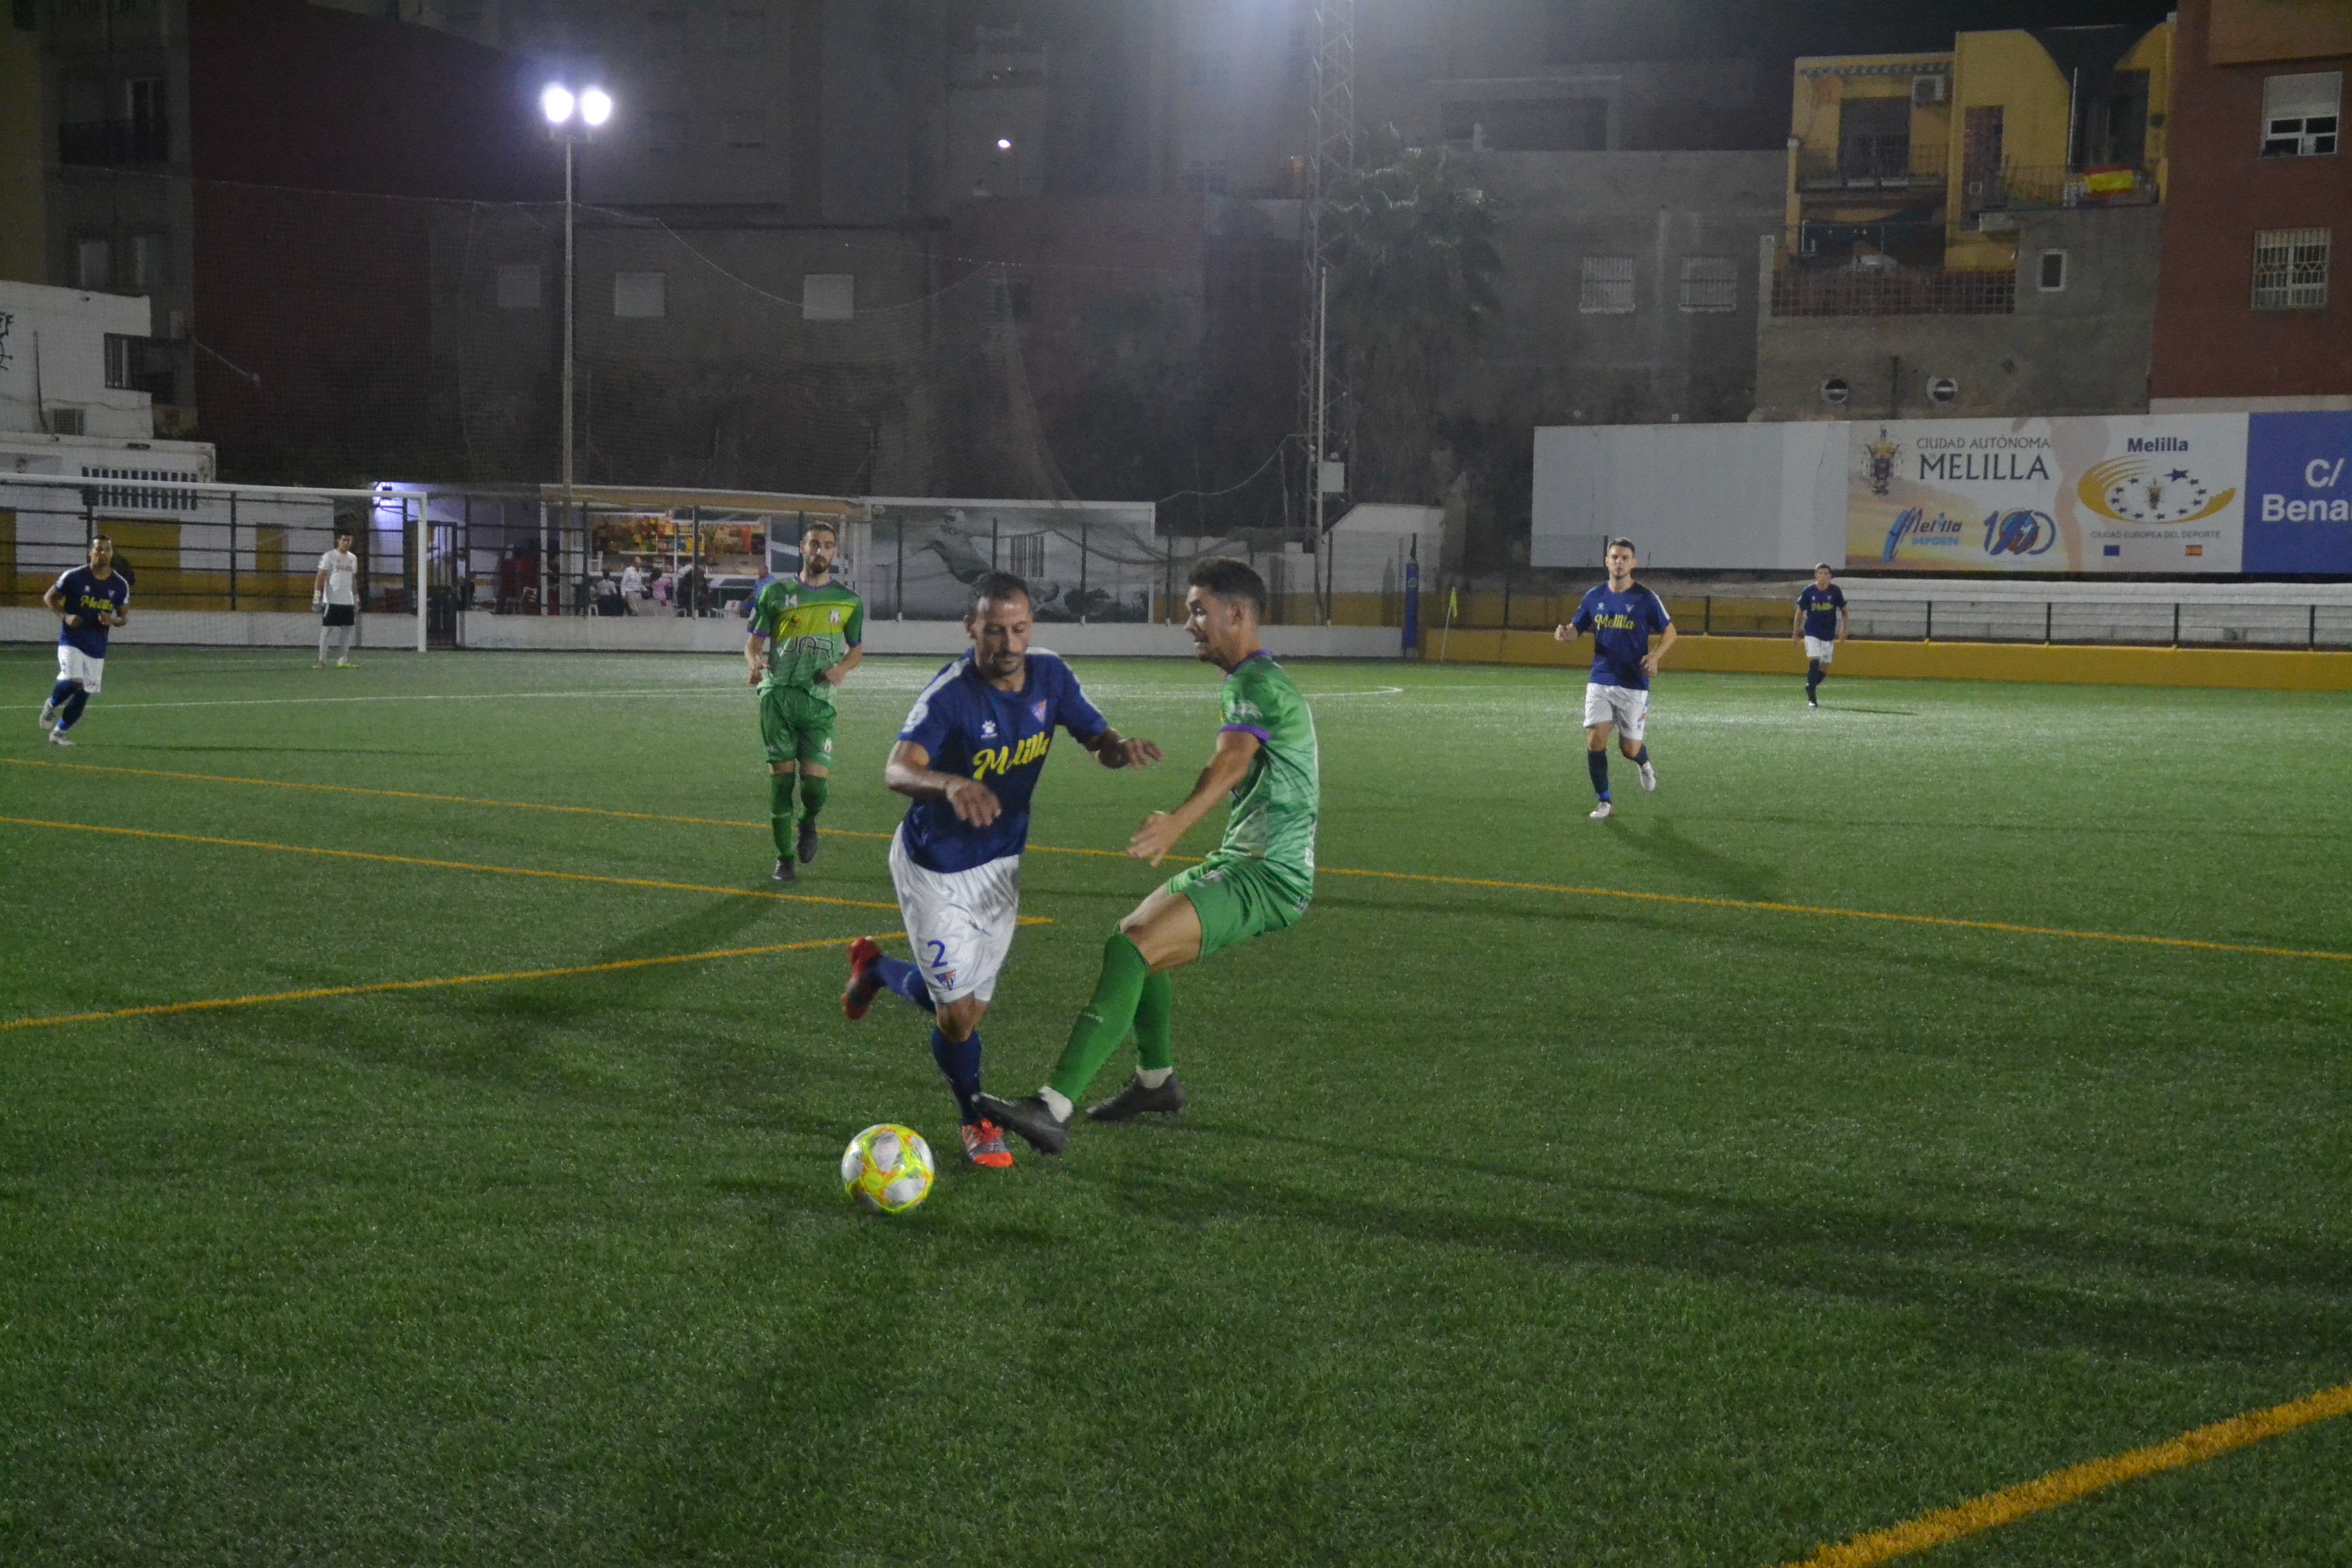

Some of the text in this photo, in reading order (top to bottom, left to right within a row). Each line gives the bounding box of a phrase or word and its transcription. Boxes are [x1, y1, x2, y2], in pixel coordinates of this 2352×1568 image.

[1916, 434, 2051, 449] CIUDAD AUTÓNOMA
[2127, 437, 2189, 452] Melilla
[1919, 453, 2050, 480] MELILLA
[2304, 458, 2345, 487] C/
[2261, 493, 2352, 522] Bena
[2182, 530, 2221, 539] DEPORTE
[785, 594, 798, 606] 14
[972, 731, 1050, 781] Mlilla
[927, 940, 948, 968] 2
